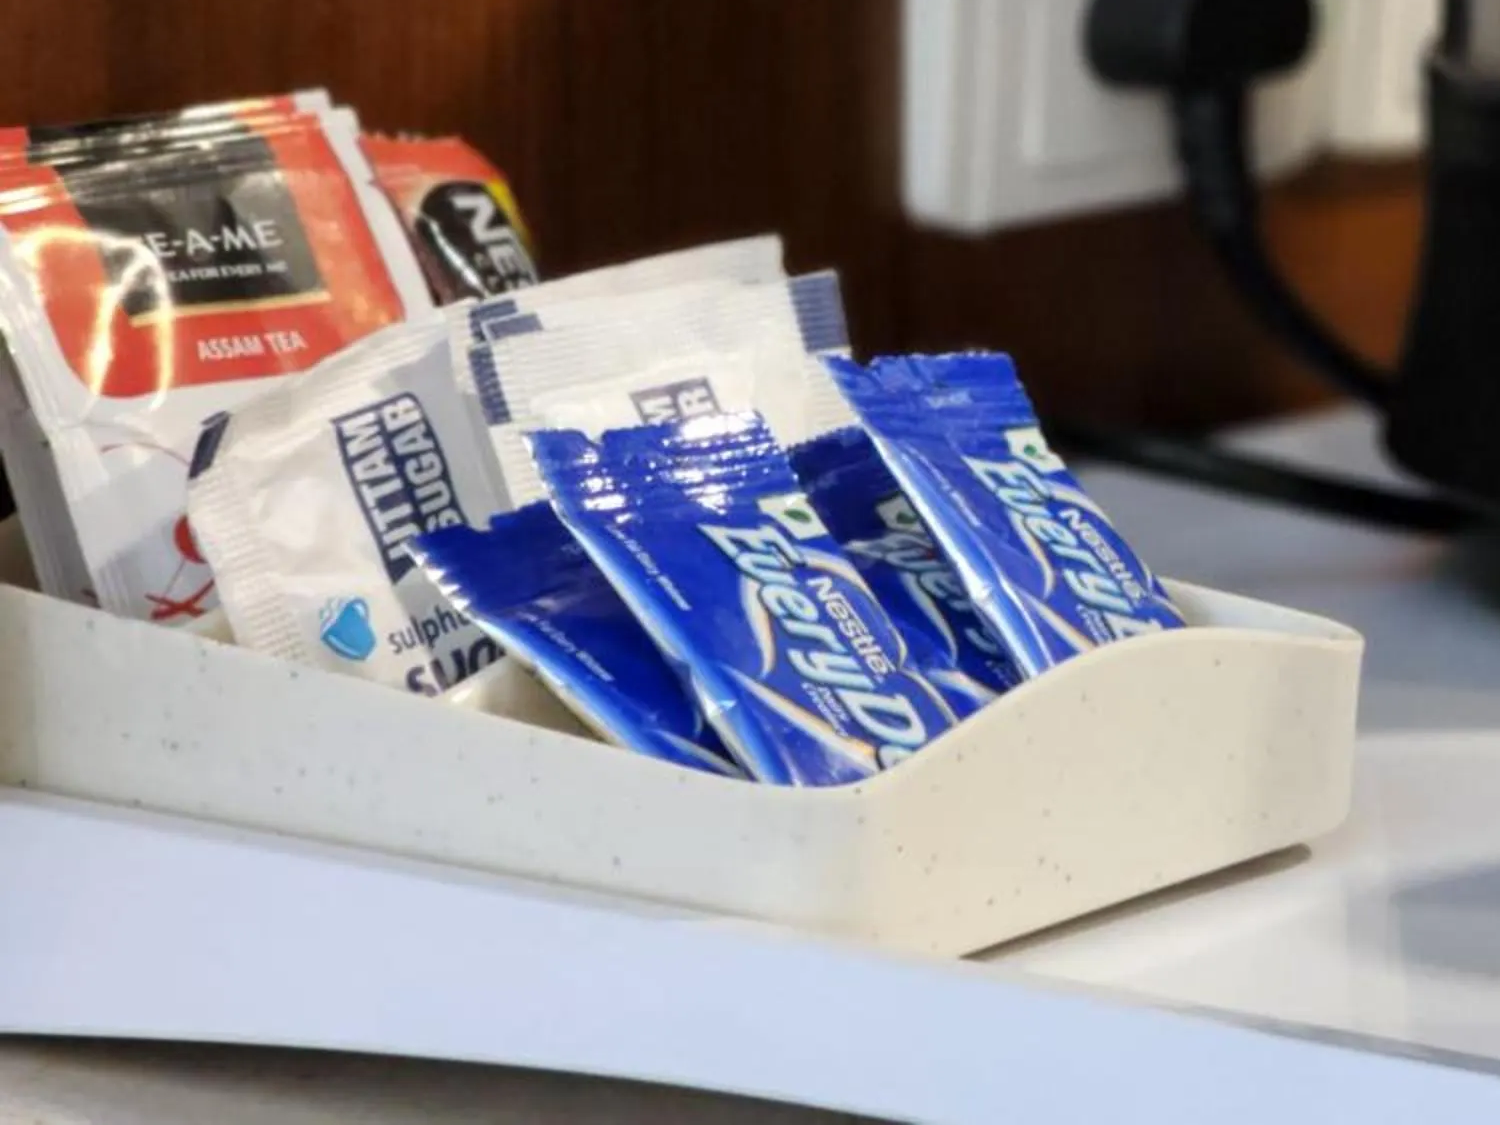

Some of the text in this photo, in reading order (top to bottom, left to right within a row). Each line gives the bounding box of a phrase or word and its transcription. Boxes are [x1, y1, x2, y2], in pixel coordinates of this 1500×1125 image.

[142, 219, 284, 257] E-A-ME
[197, 331, 308, 361] ASSAM TEA
[381, 396, 463, 534] SUGAR
